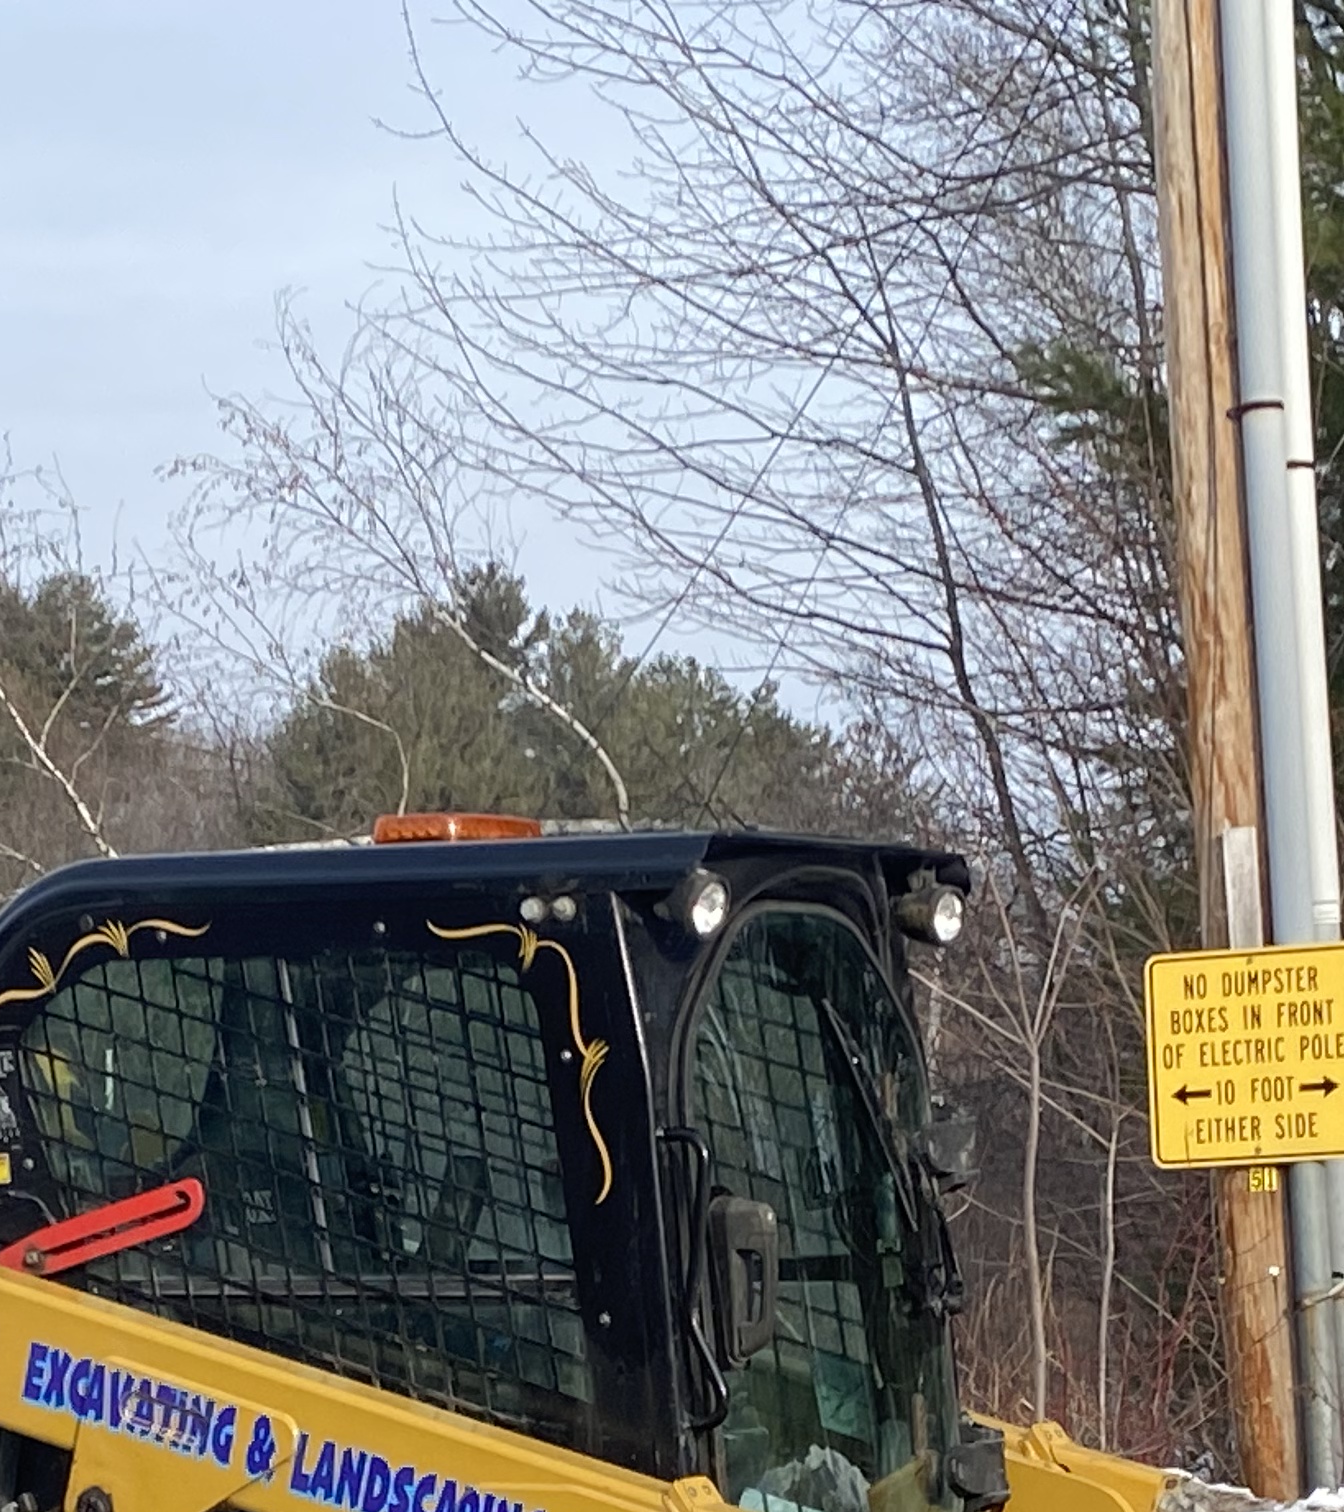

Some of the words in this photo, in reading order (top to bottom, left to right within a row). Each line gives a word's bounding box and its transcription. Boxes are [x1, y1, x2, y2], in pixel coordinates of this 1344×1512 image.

[1184, 974, 1207, 1000] NO
[1222, 966, 1319, 997] DUMPSTER
[1170, 1006, 1229, 1035] BOXES
[1243, 1004, 1262, 1030] IN
[1277, 999, 1334, 1028] FRONT
[1162, 1043, 1186, 1070] OF
[1199, 1037, 1286, 1068] ELECTRIC
[1216, 1079, 1236, 1106] 10
[1250, 1076, 1295, 1104] FOOT
[1196, 1115, 1262, 1144] EITHER
[1275, 1112, 1319, 1139] SIDE
[21, 1341, 238, 1467] EXCAVATING
[245, 1414, 276, 1478] &
